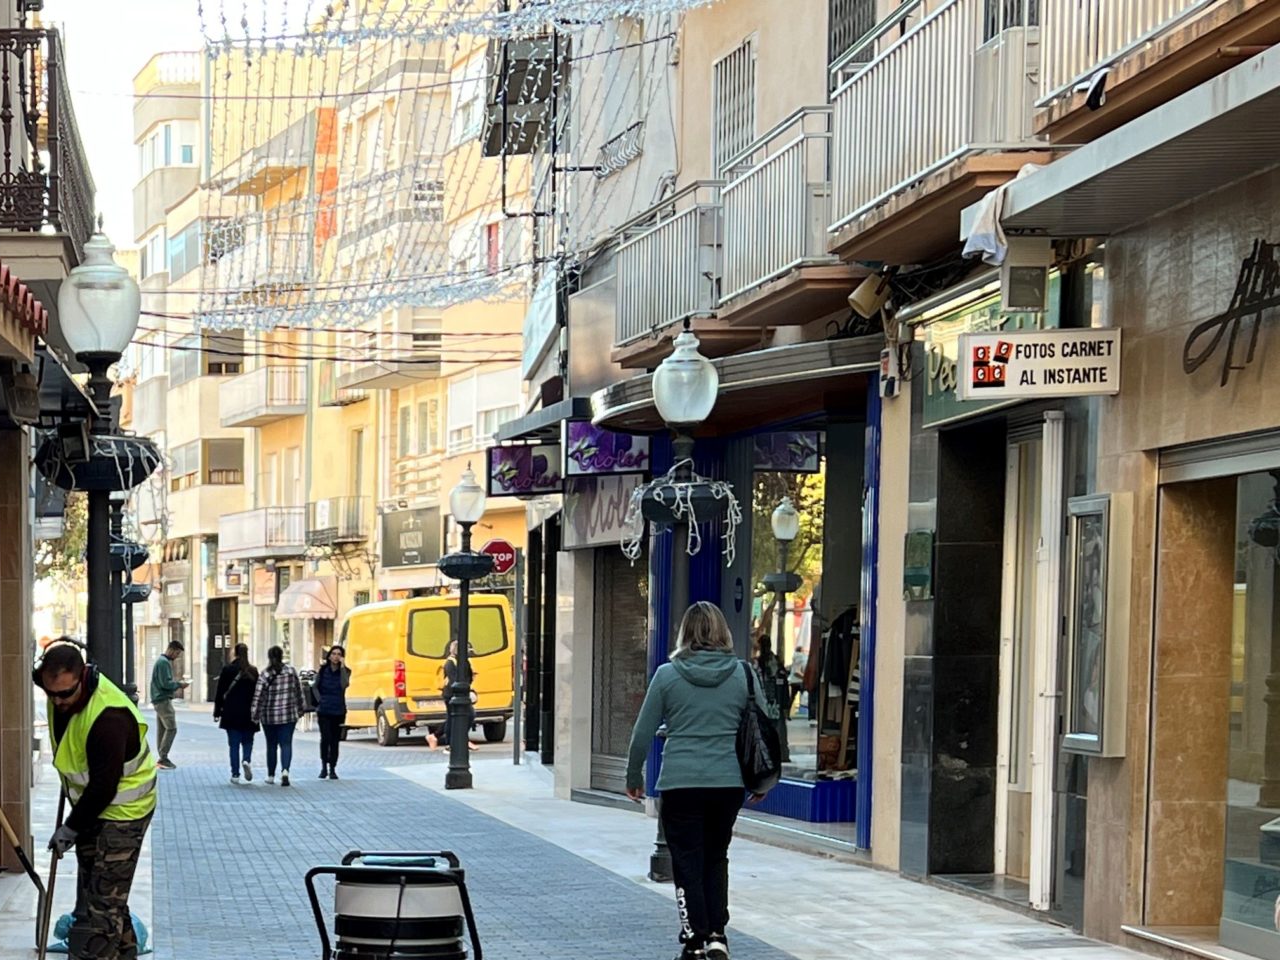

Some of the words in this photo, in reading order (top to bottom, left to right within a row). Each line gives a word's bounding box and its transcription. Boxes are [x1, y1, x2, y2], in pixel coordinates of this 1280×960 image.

[1015, 343, 1055, 359] FOTOS
[1061, 340, 1113, 357] CARNET
[1020, 369, 1036, 385] AL
[1044, 367, 1107, 384] INSTANTE
[492, 553, 512, 561] TOP
